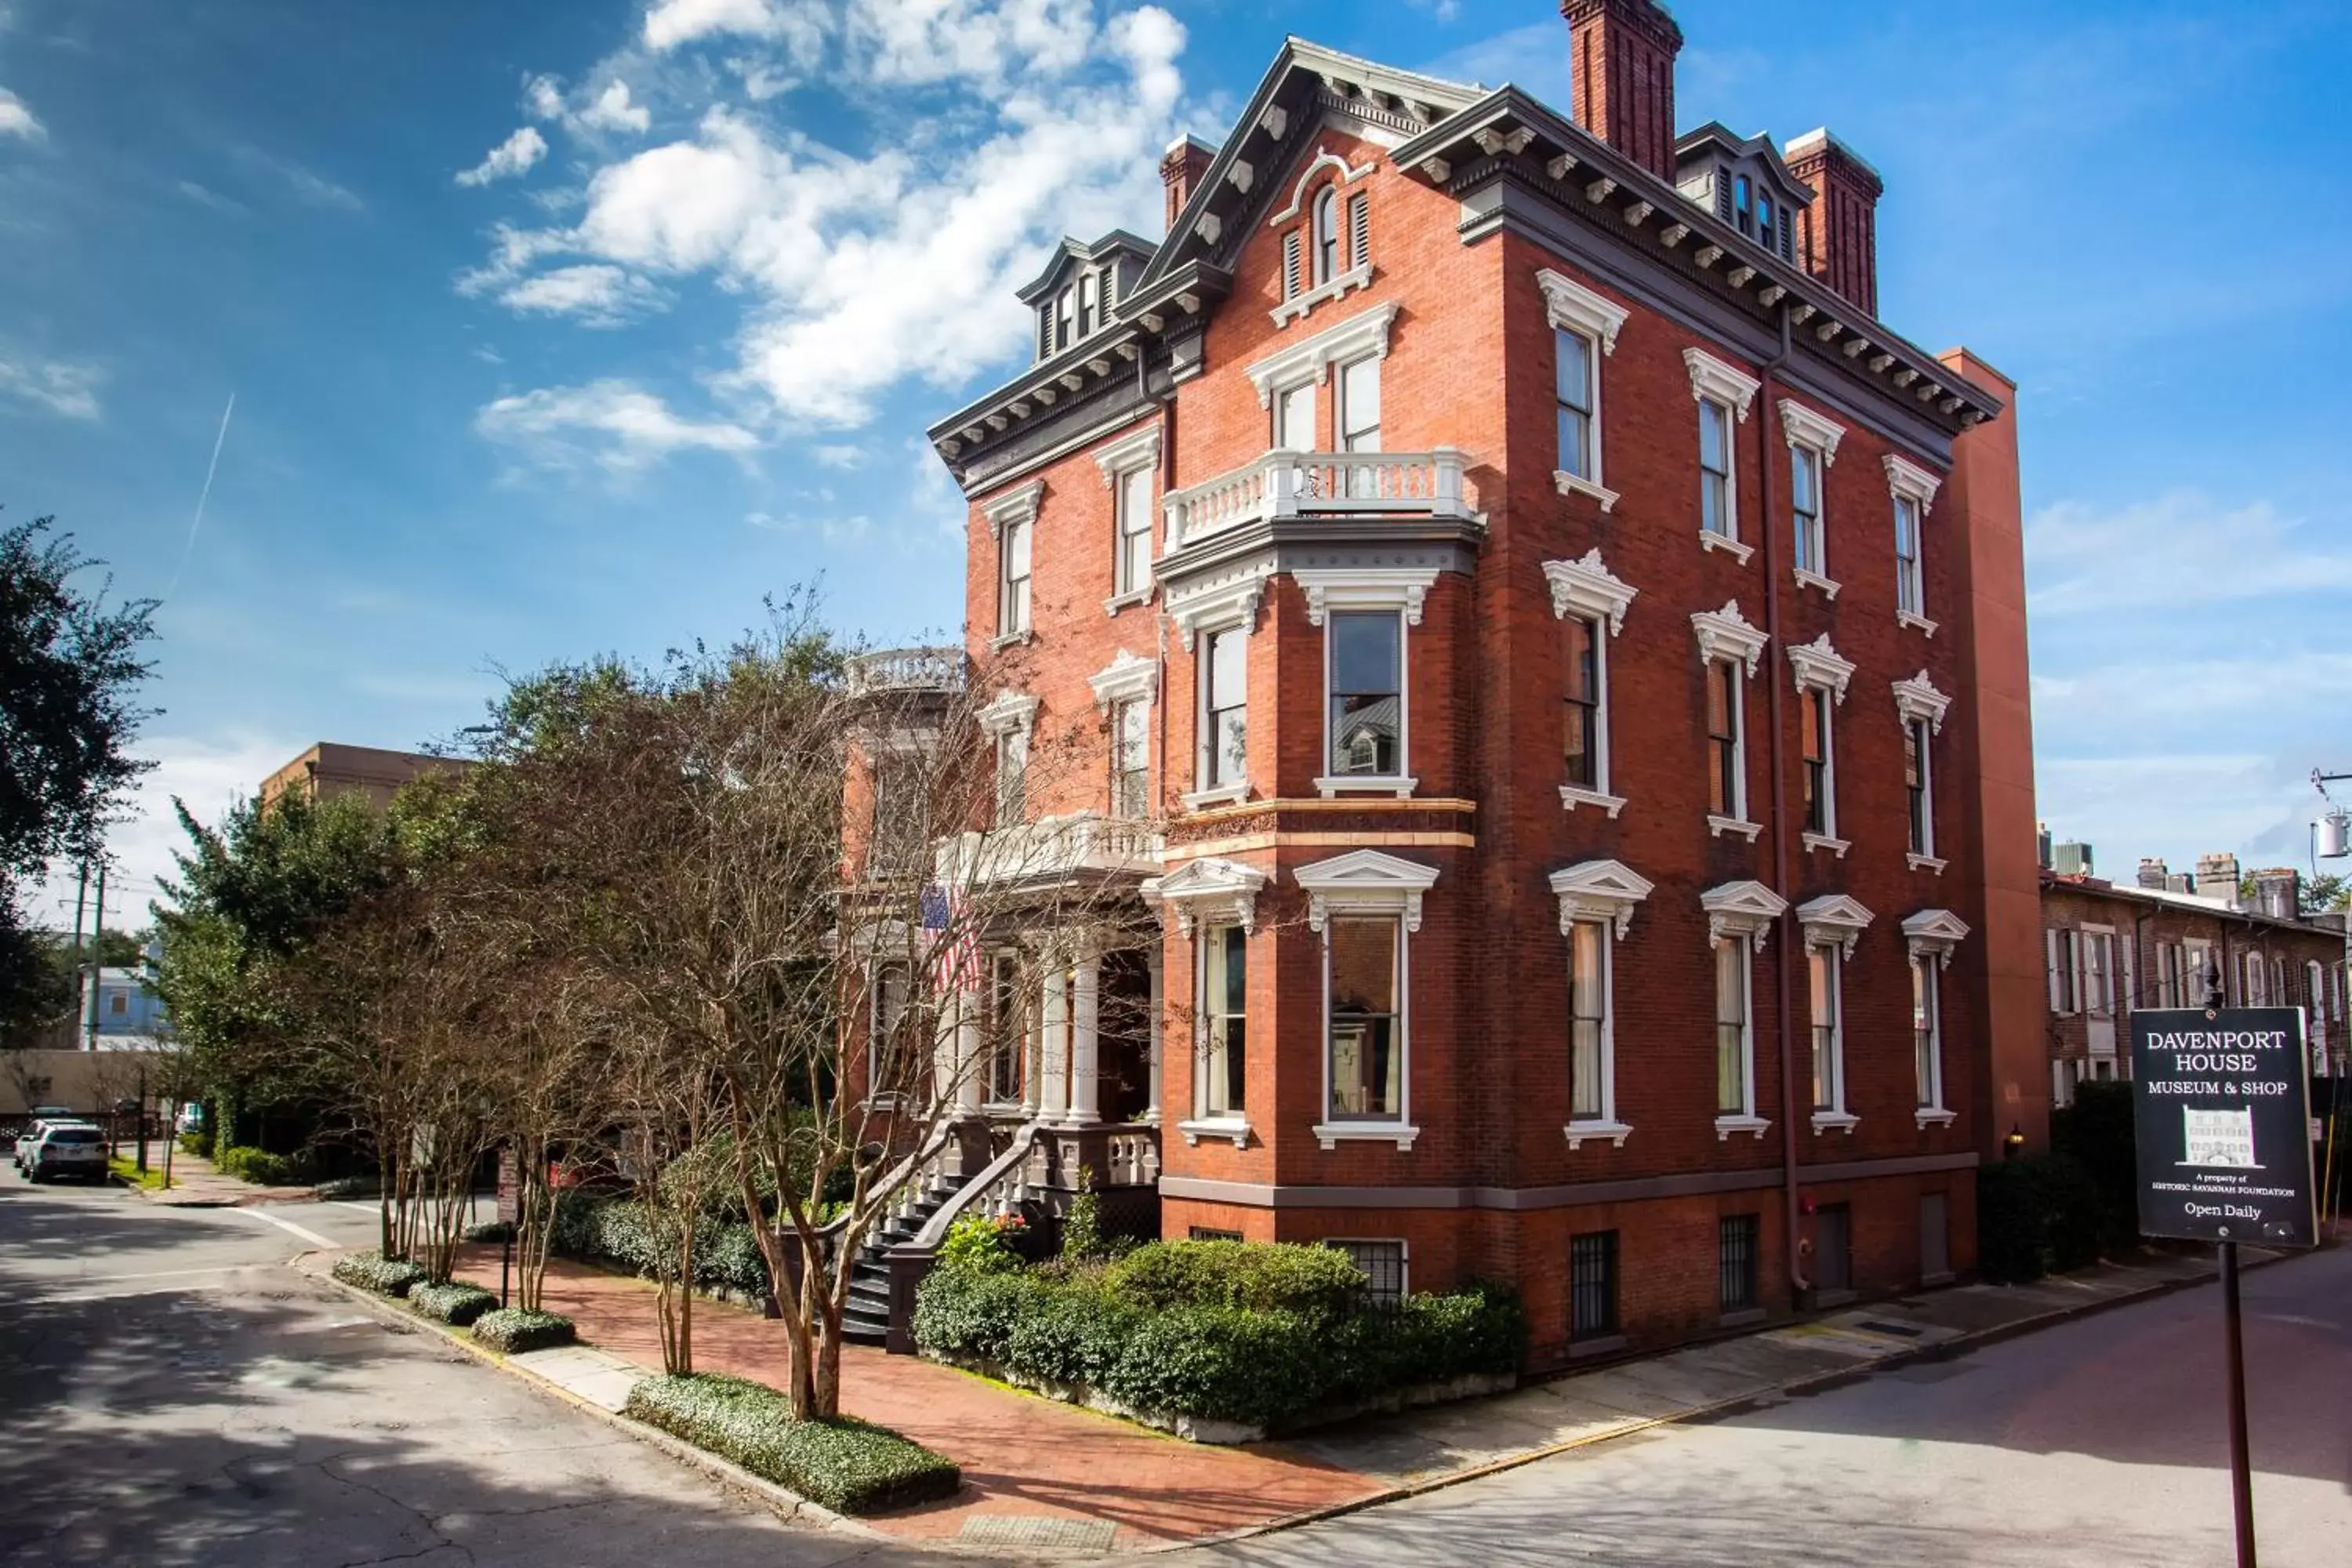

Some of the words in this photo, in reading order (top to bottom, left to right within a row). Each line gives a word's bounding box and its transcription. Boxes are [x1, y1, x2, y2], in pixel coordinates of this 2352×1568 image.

[2147, 1031, 2285, 1050] DAVENPORT
[2175, 1054, 2257, 1072] HOUSE
[2148, 1081, 2219, 1094] MUSEUM
[2224, 1081, 2238, 1094] &
[2241, 1081, 2288, 1095] SHOP
[2204, 1174, 2236, 1183] property
[2152, 1182, 2190, 1191] HISTORIC
[2192, 1184, 2235, 1193] SAVANNAH
[2238, 1187, 2295, 1197] FOUNDATION
[2184, 1202, 2222, 1217] Open
[2224, 1204, 2262, 1221] Daily
